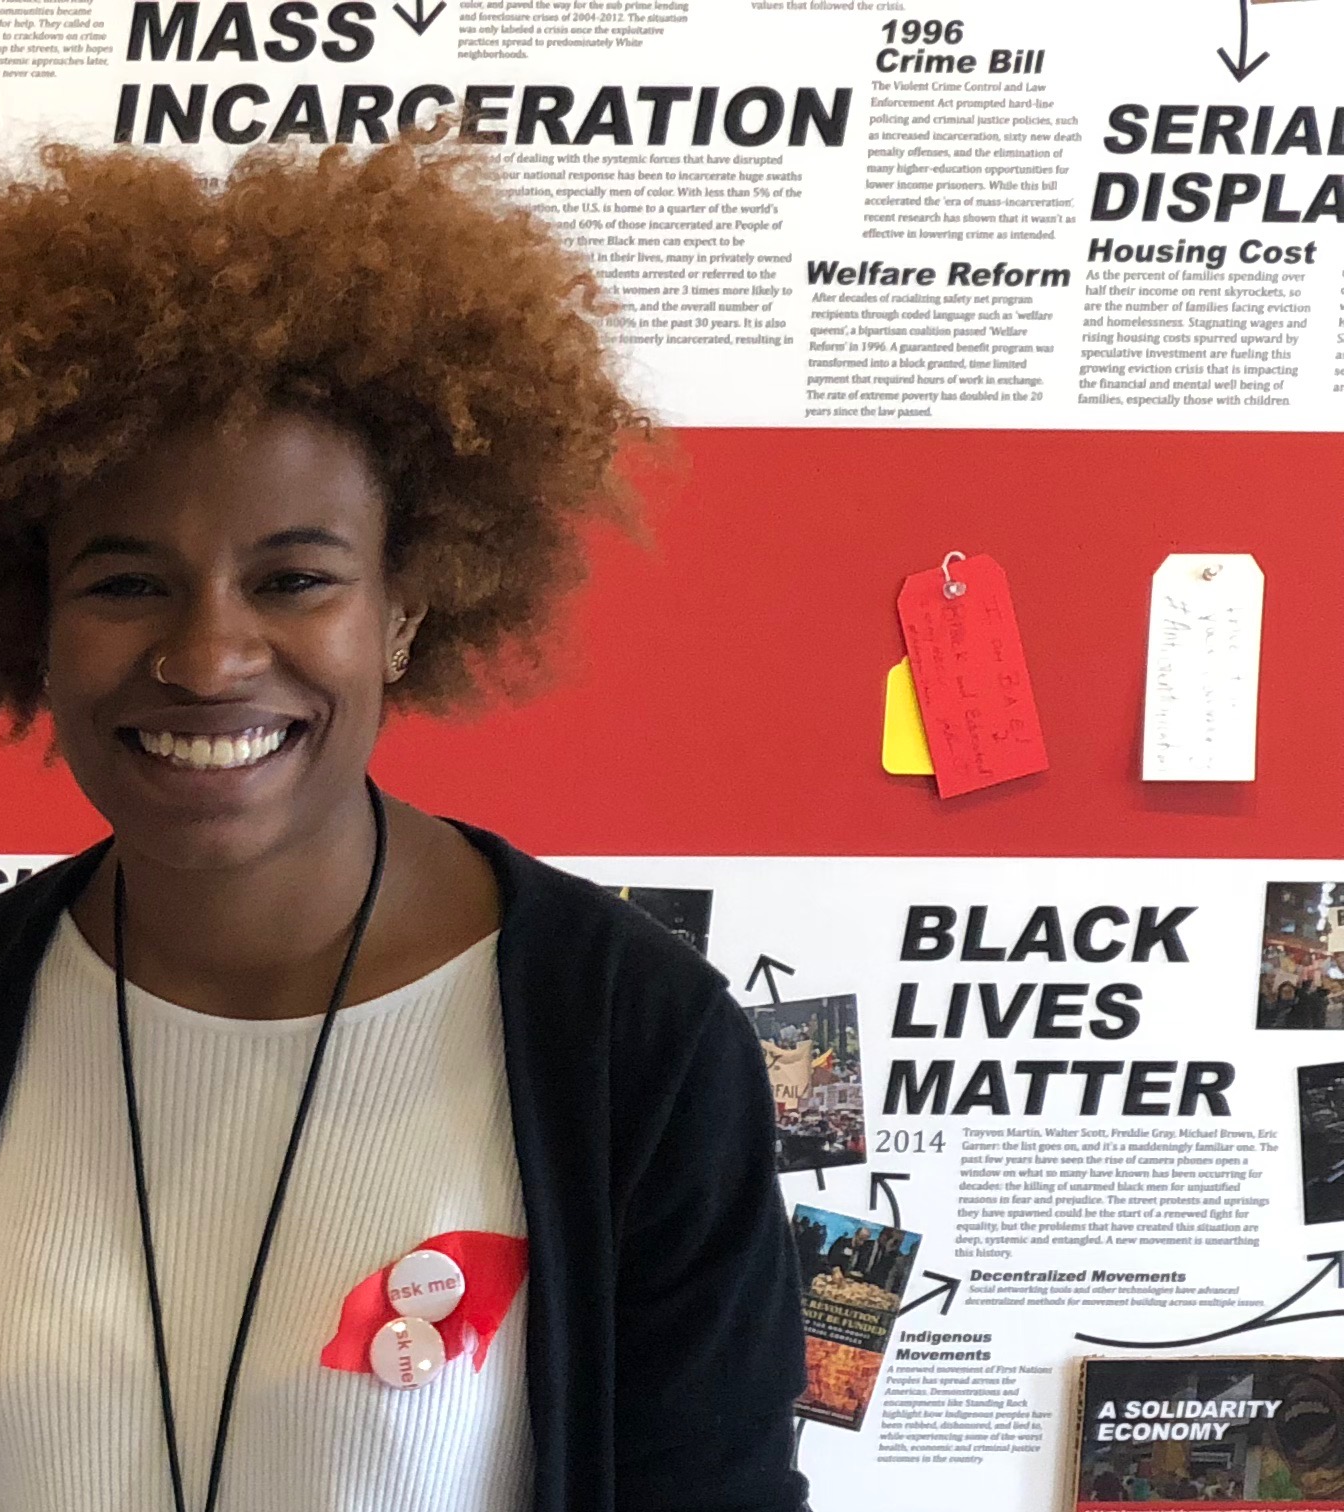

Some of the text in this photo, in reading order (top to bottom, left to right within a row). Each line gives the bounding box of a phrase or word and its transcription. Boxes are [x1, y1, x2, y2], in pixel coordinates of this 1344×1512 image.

[126, 0, 376, 63] MASS
[882, 19, 964, 44] 1996
[876, 48, 1045, 74] Crime Bill
[114, 83, 852, 149] INCARCERATION
[1088, 238, 1317, 271] Housing Cost
[808, 260, 1070, 287] Welfare Reform
[900, 905, 1198, 963] BLACK
[891, 983, 1142, 1040] LIVES
[882, 1060, 1235, 1116] MATTER
[875, 1129, 946, 1153] 2014
[390, 1273, 462, 1302] ask me!
[970, 1269, 1186, 1283] Decentralized Movements
[900, 1331, 991, 1346] Indigenous
[896, 1348, 991, 1361] Movements
[1098, 1398, 1282, 1421] A SOLIDARITY
[1097, 1422, 1230, 1442] ECONOMY
